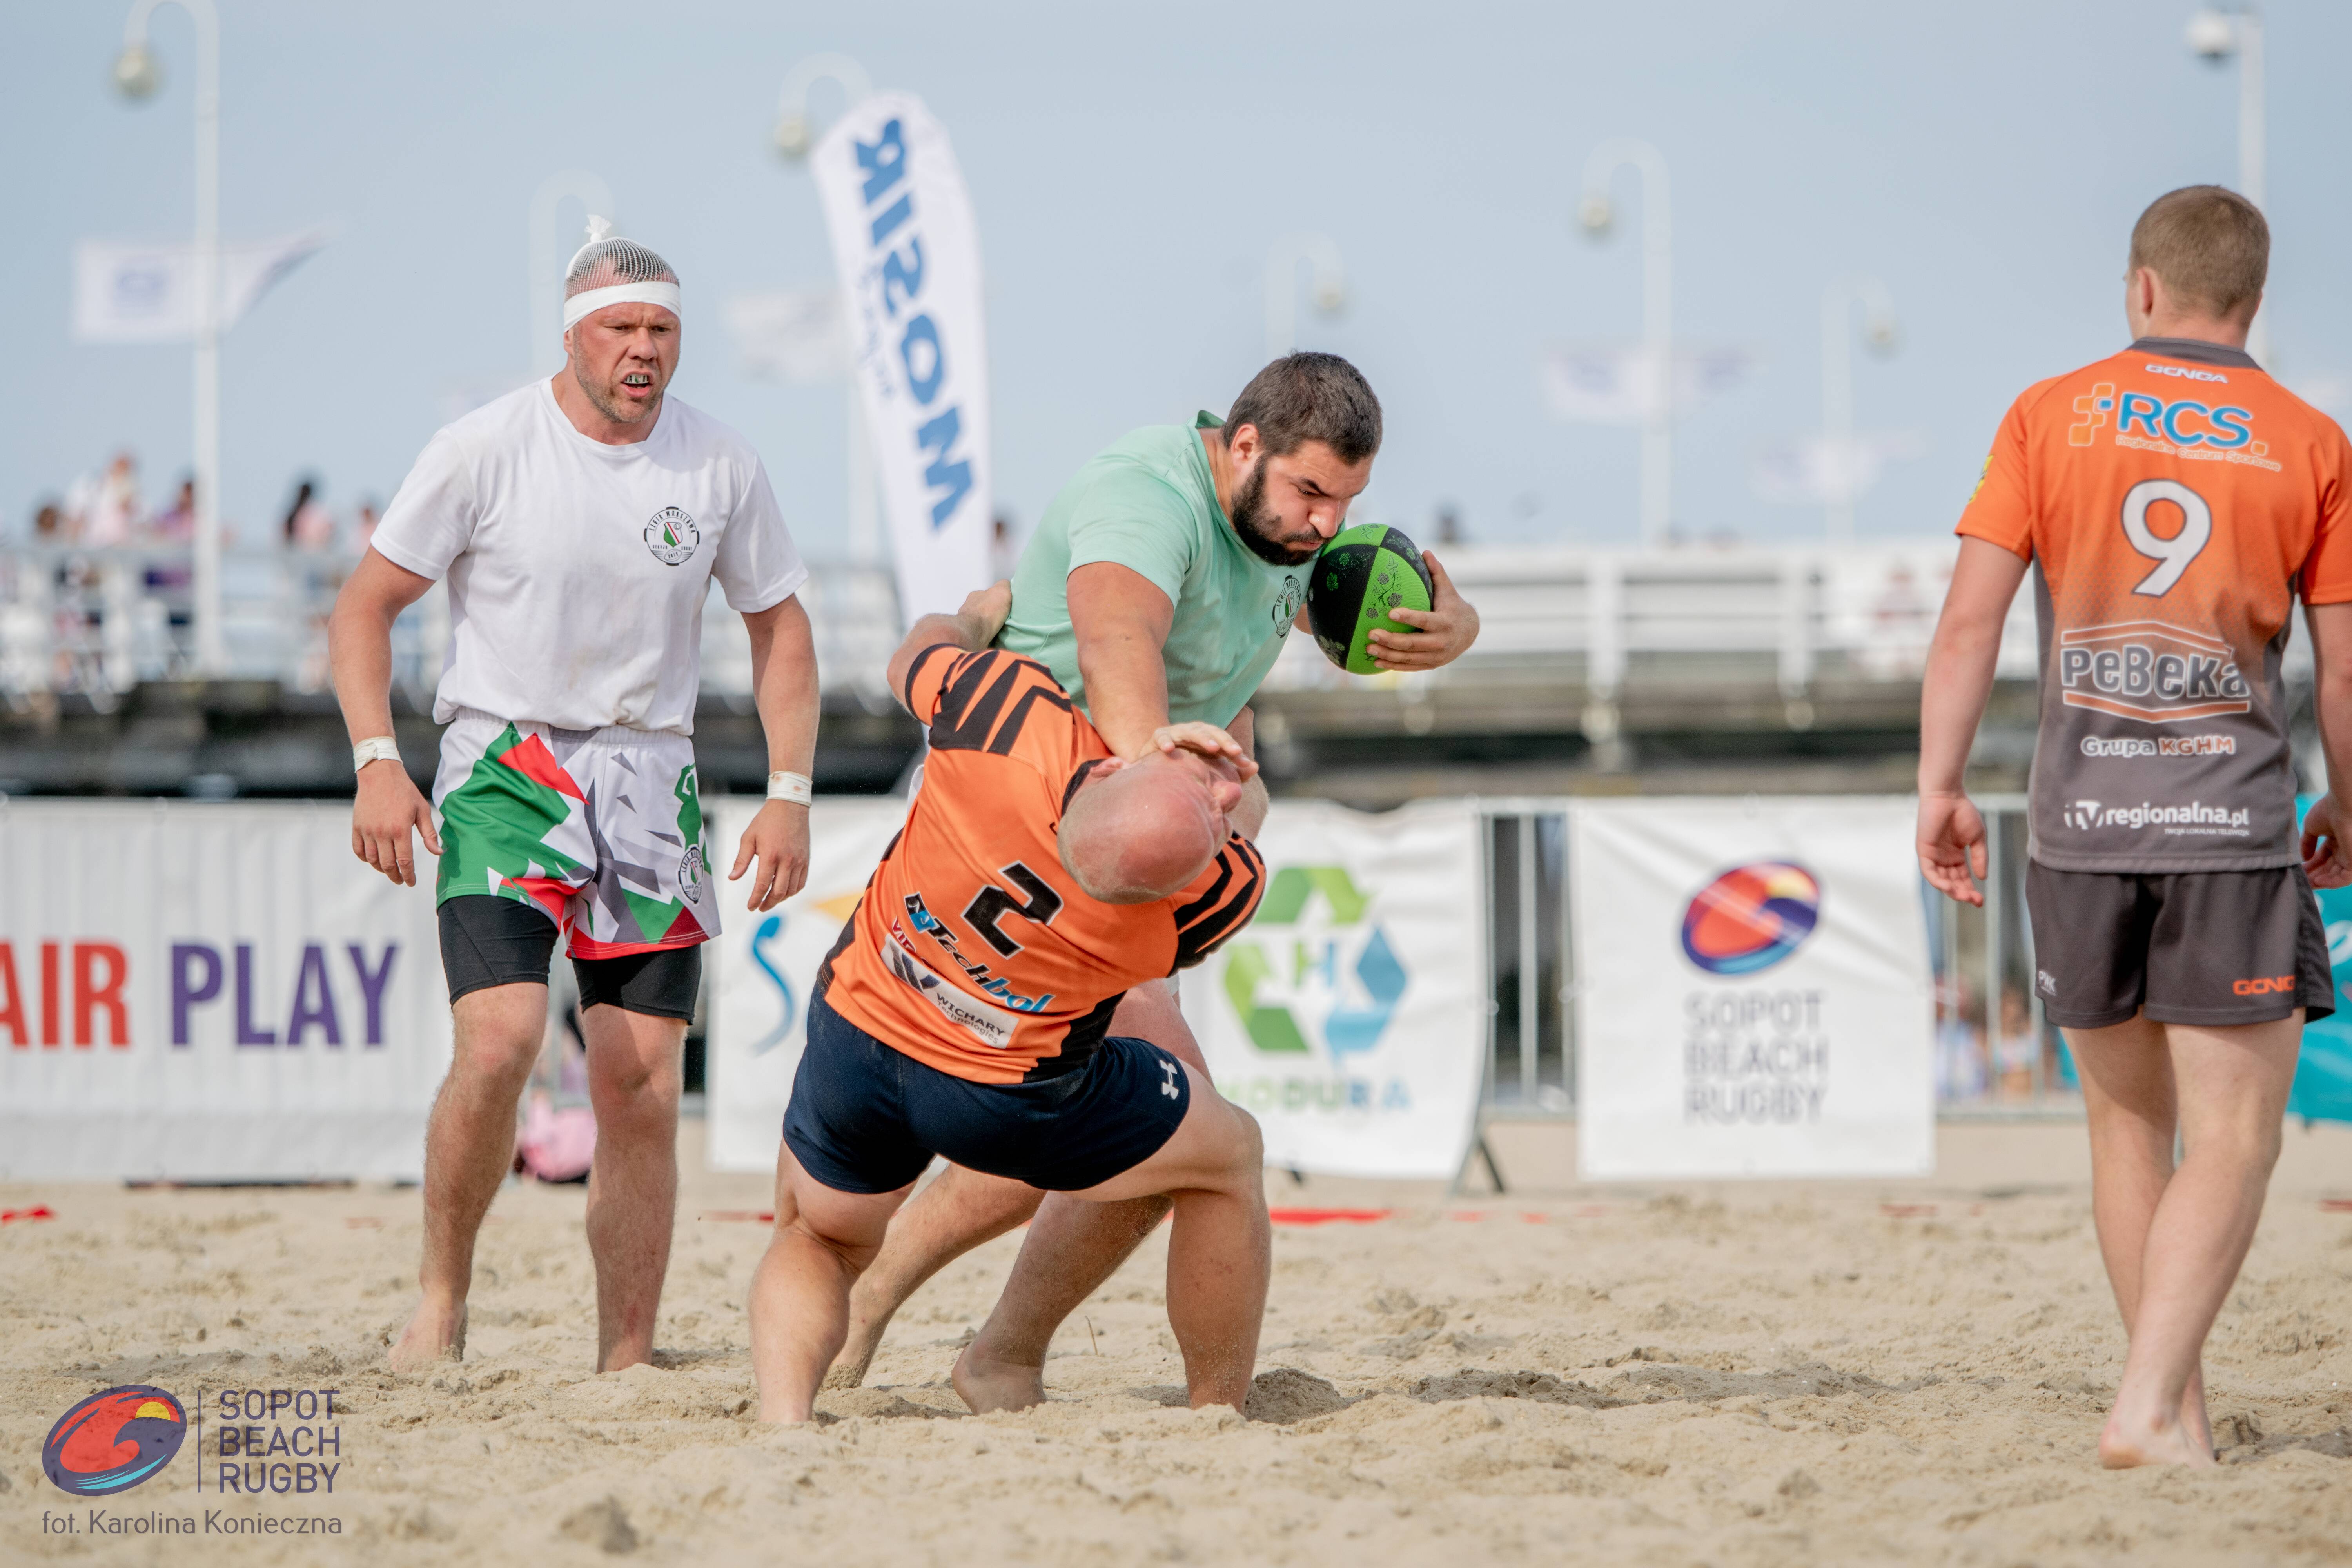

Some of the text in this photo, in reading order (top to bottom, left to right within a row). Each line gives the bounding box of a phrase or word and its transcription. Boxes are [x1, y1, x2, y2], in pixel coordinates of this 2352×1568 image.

[2117, 392, 2253, 448] RCS
[2116, 435, 2281, 472] Regionalne Centrum Sportowe
[649, 514, 663, 531] LEGIA
[2121, 478, 2212, 599] 9
[2080, 736, 2235, 757] Grupa KGHM
[961, 860, 1064, 960] 2
[170, 941, 399, 1048] PLAY
[937, 993, 1005, 1036] WICHARY
[1683, 989, 1826, 1035] SOPOT
[937, 1000, 999, 1044] Technologies
[1684, 1037, 1829, 1081] BEACH
[1684, 1083, 1827, 1125] RUGBY
